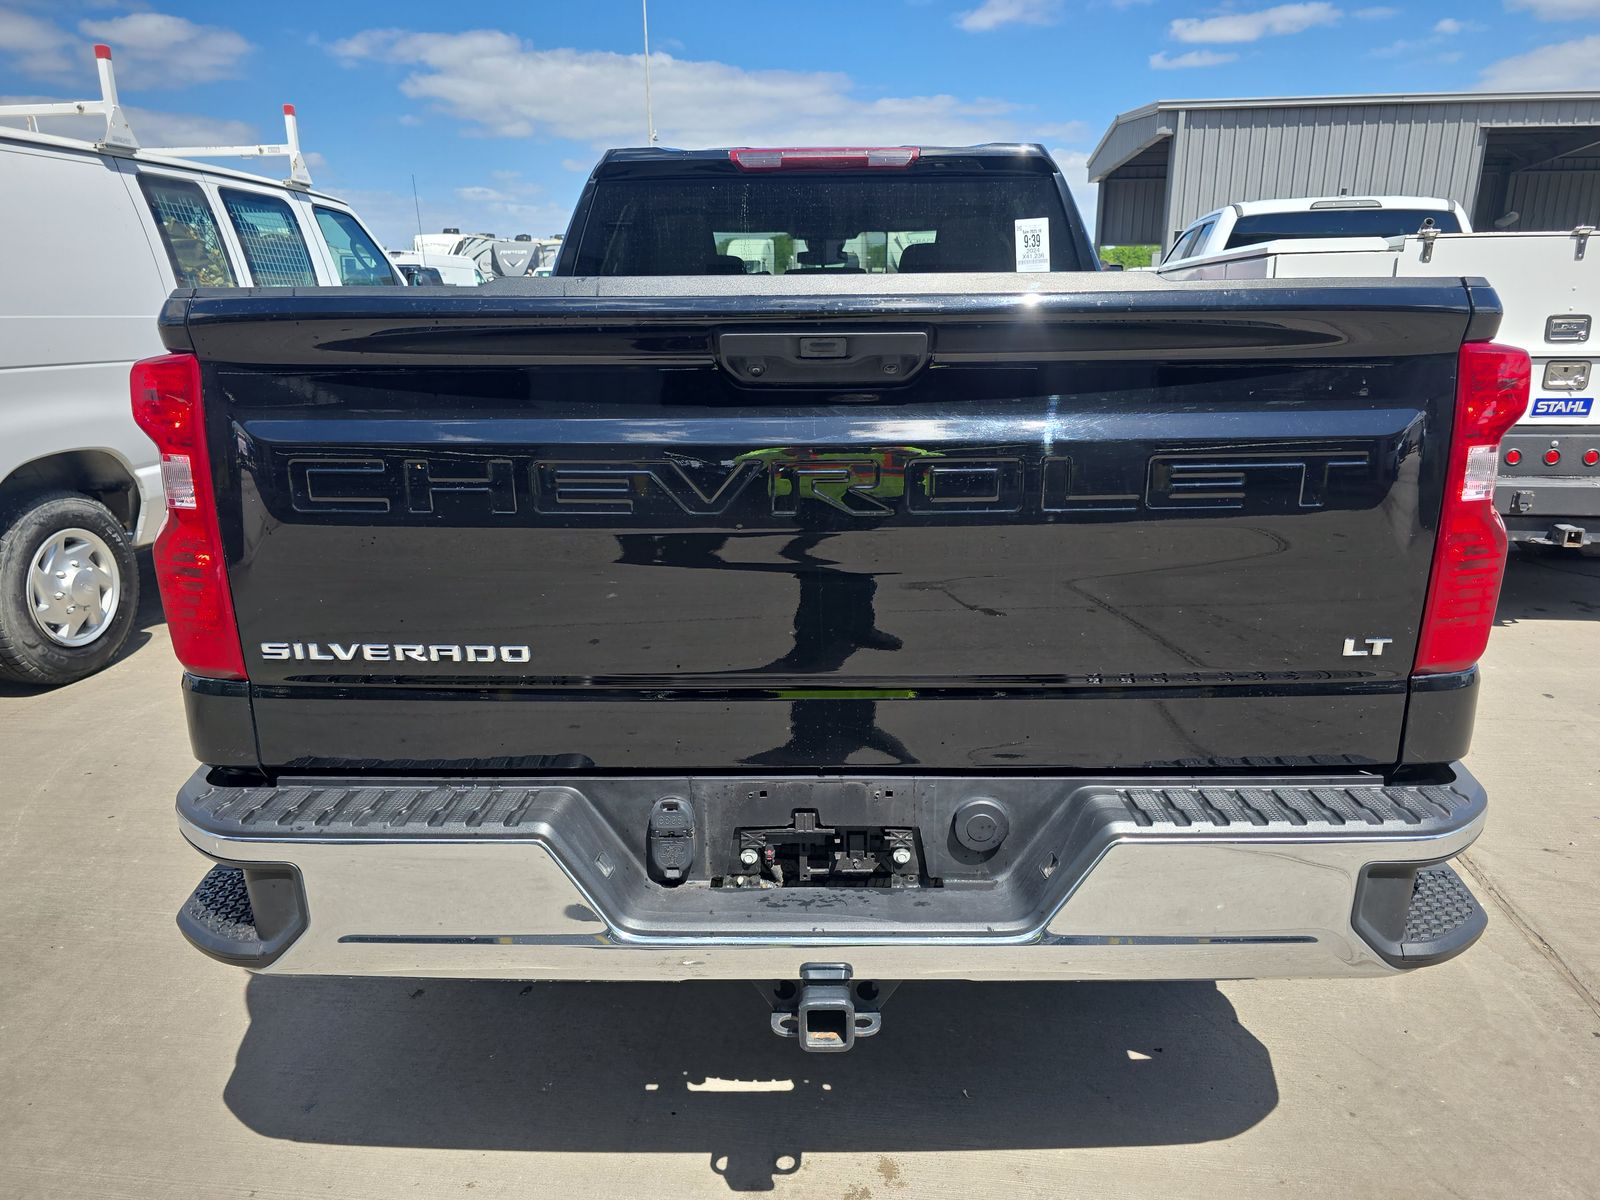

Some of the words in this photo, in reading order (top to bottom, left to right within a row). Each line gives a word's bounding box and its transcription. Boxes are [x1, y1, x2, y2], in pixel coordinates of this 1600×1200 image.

[1024, 234, 1041, 248] 9:39
[1535, 401, 1588, 413] STAHL
[287, 451, 1370, 516] CHEVROLET
[260, 642, 532, 664] SILVERADO
[1342, 637, 1393, 657] LT
